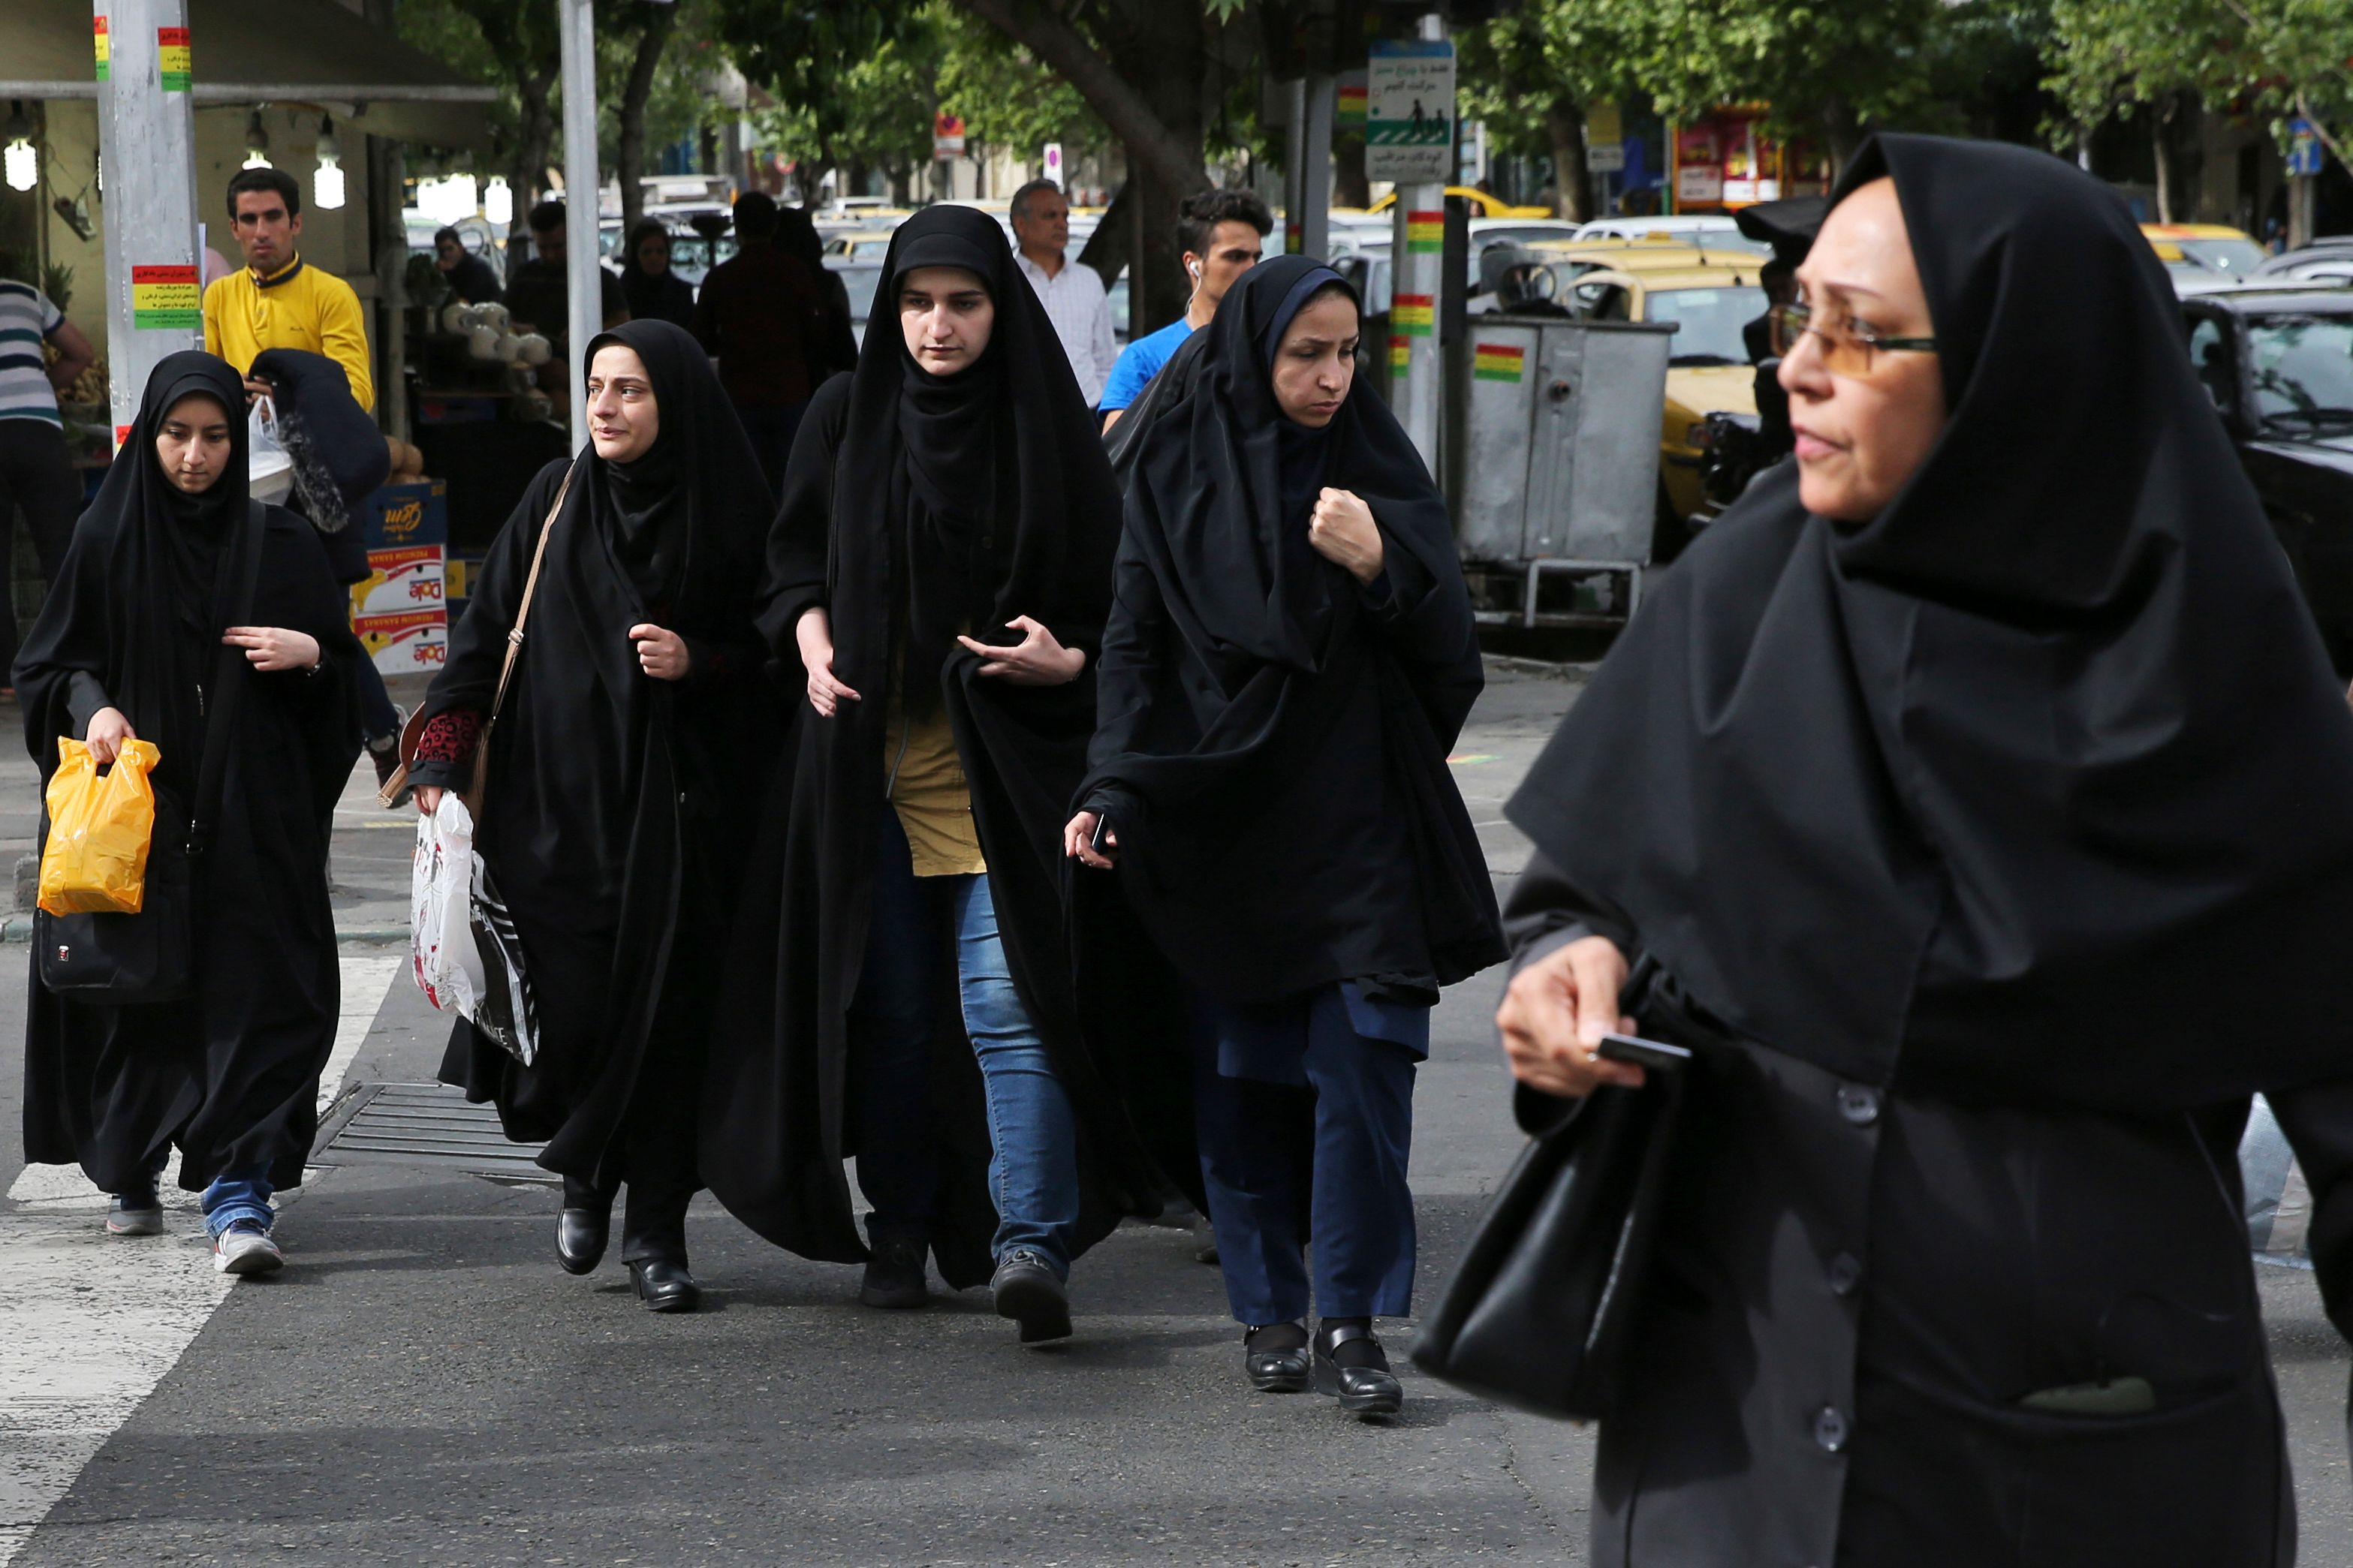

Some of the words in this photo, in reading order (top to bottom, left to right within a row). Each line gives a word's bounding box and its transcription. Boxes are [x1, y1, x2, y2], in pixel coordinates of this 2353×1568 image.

[369, 552, 395, 564] BANAN
[409, 581, 441, 601] Dole
[364, 617, 400, 628] BANANAS
[414, 645, 445, 666] Dole
